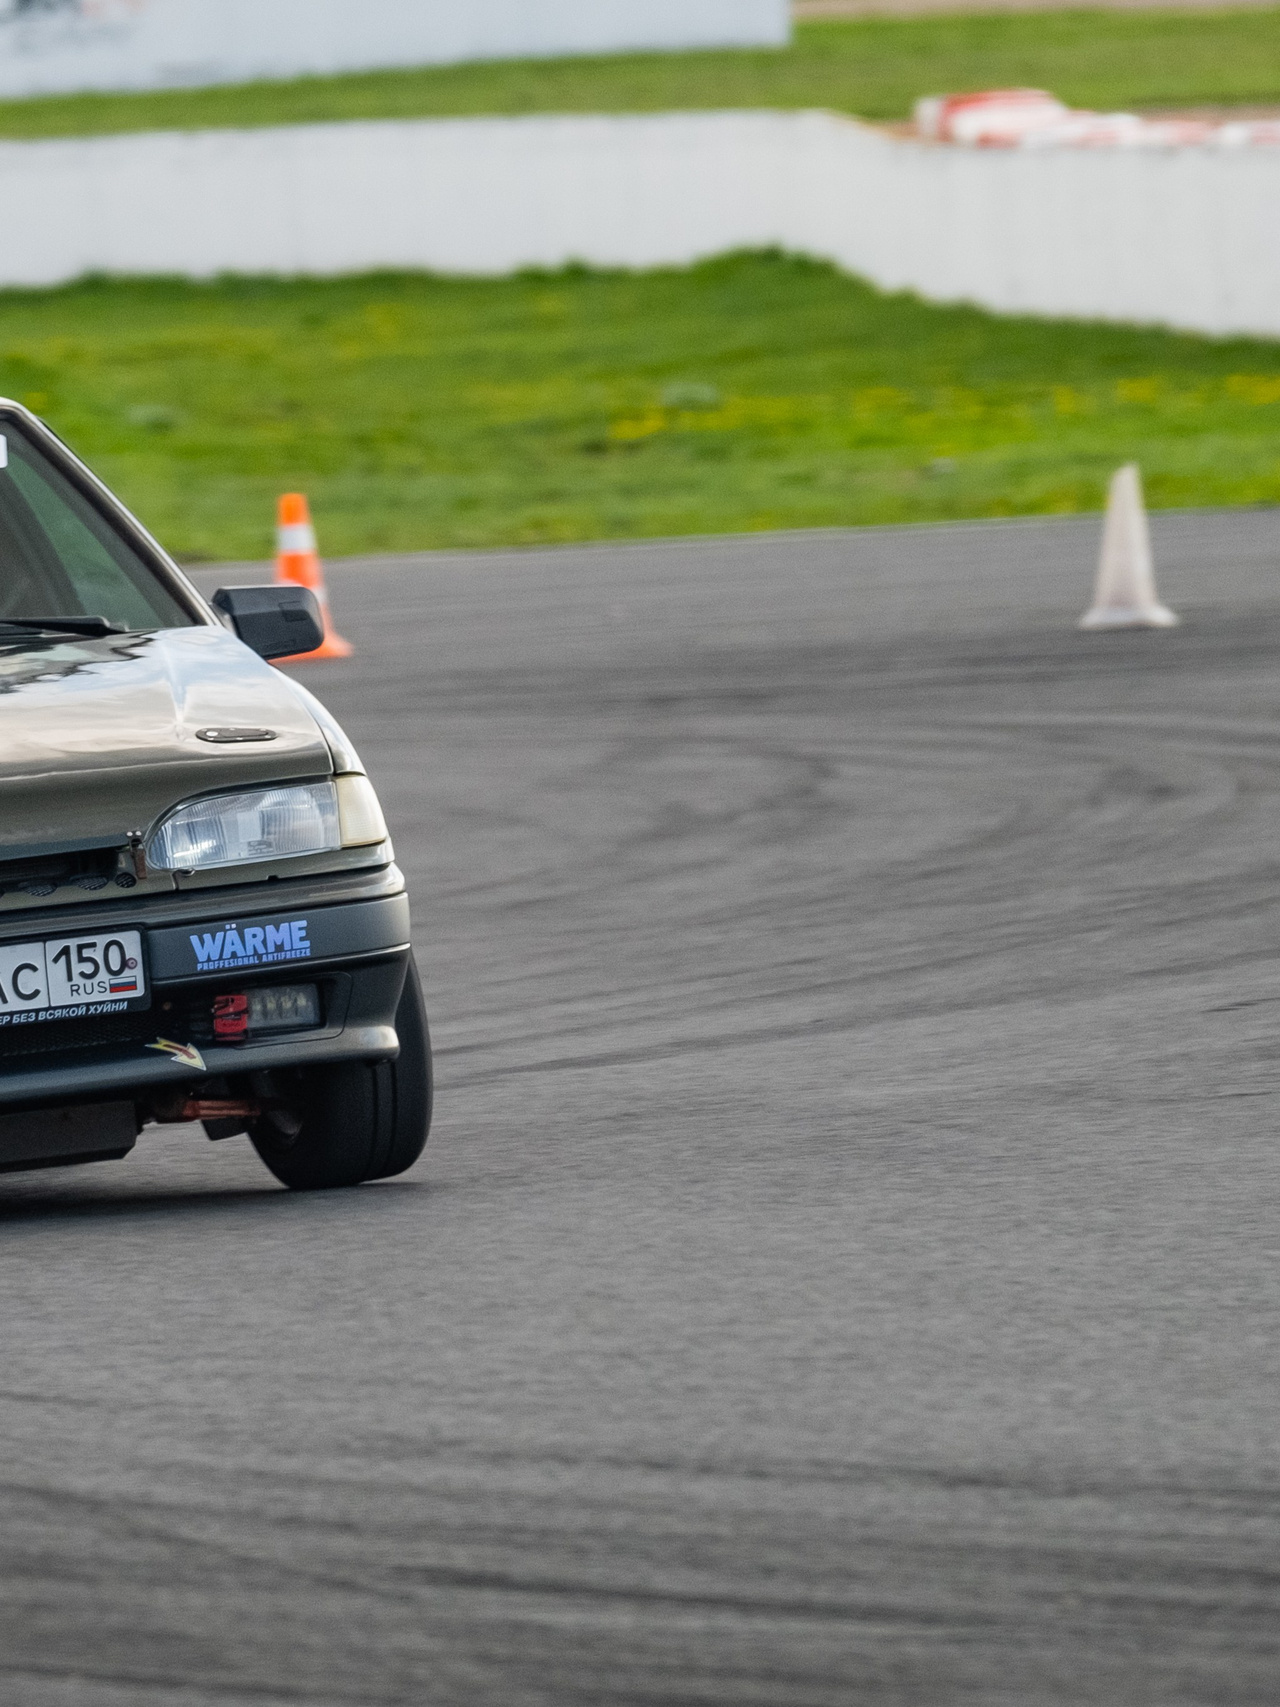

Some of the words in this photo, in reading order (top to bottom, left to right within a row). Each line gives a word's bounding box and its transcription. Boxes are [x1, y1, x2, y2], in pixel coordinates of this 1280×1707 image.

[190, 920, 311, 962] WÄRME
[51, 939, 128, 983] 150
[262, 949, 311, 962] ANTIFREEZE
[70, 981, 108, 997] RUS
[12, 1012, 36, 1024] БЕЗ
[38, 1004, 86, 1021] ВСЯКОЙ
[88, 1000, 129, 1015] ХУЙНИ
